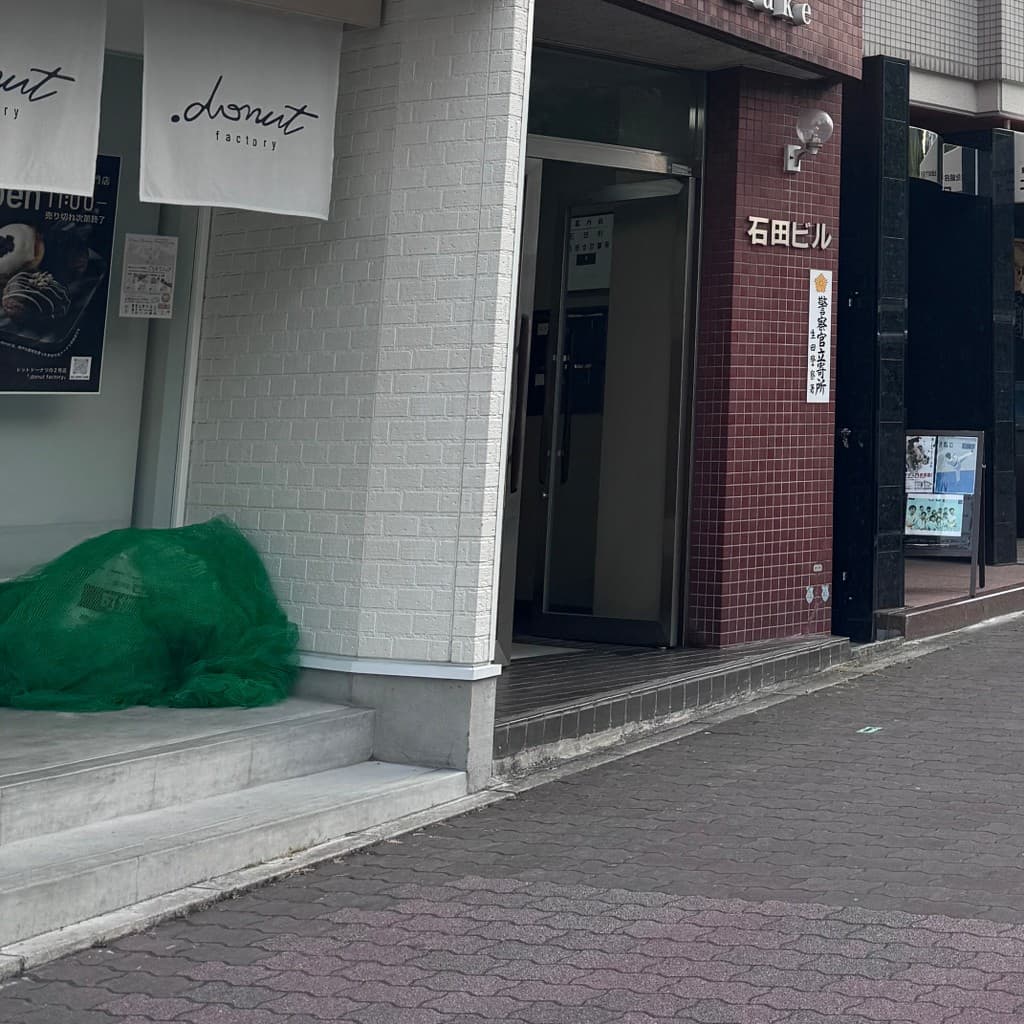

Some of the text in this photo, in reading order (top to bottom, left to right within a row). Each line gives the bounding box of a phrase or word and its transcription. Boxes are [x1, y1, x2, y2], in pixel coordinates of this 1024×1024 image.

[216, 130, 277, 151] factory
[747, 216, 832, 250] 石田ビル
[815, 295, 829, 395] 警察官立寄所
